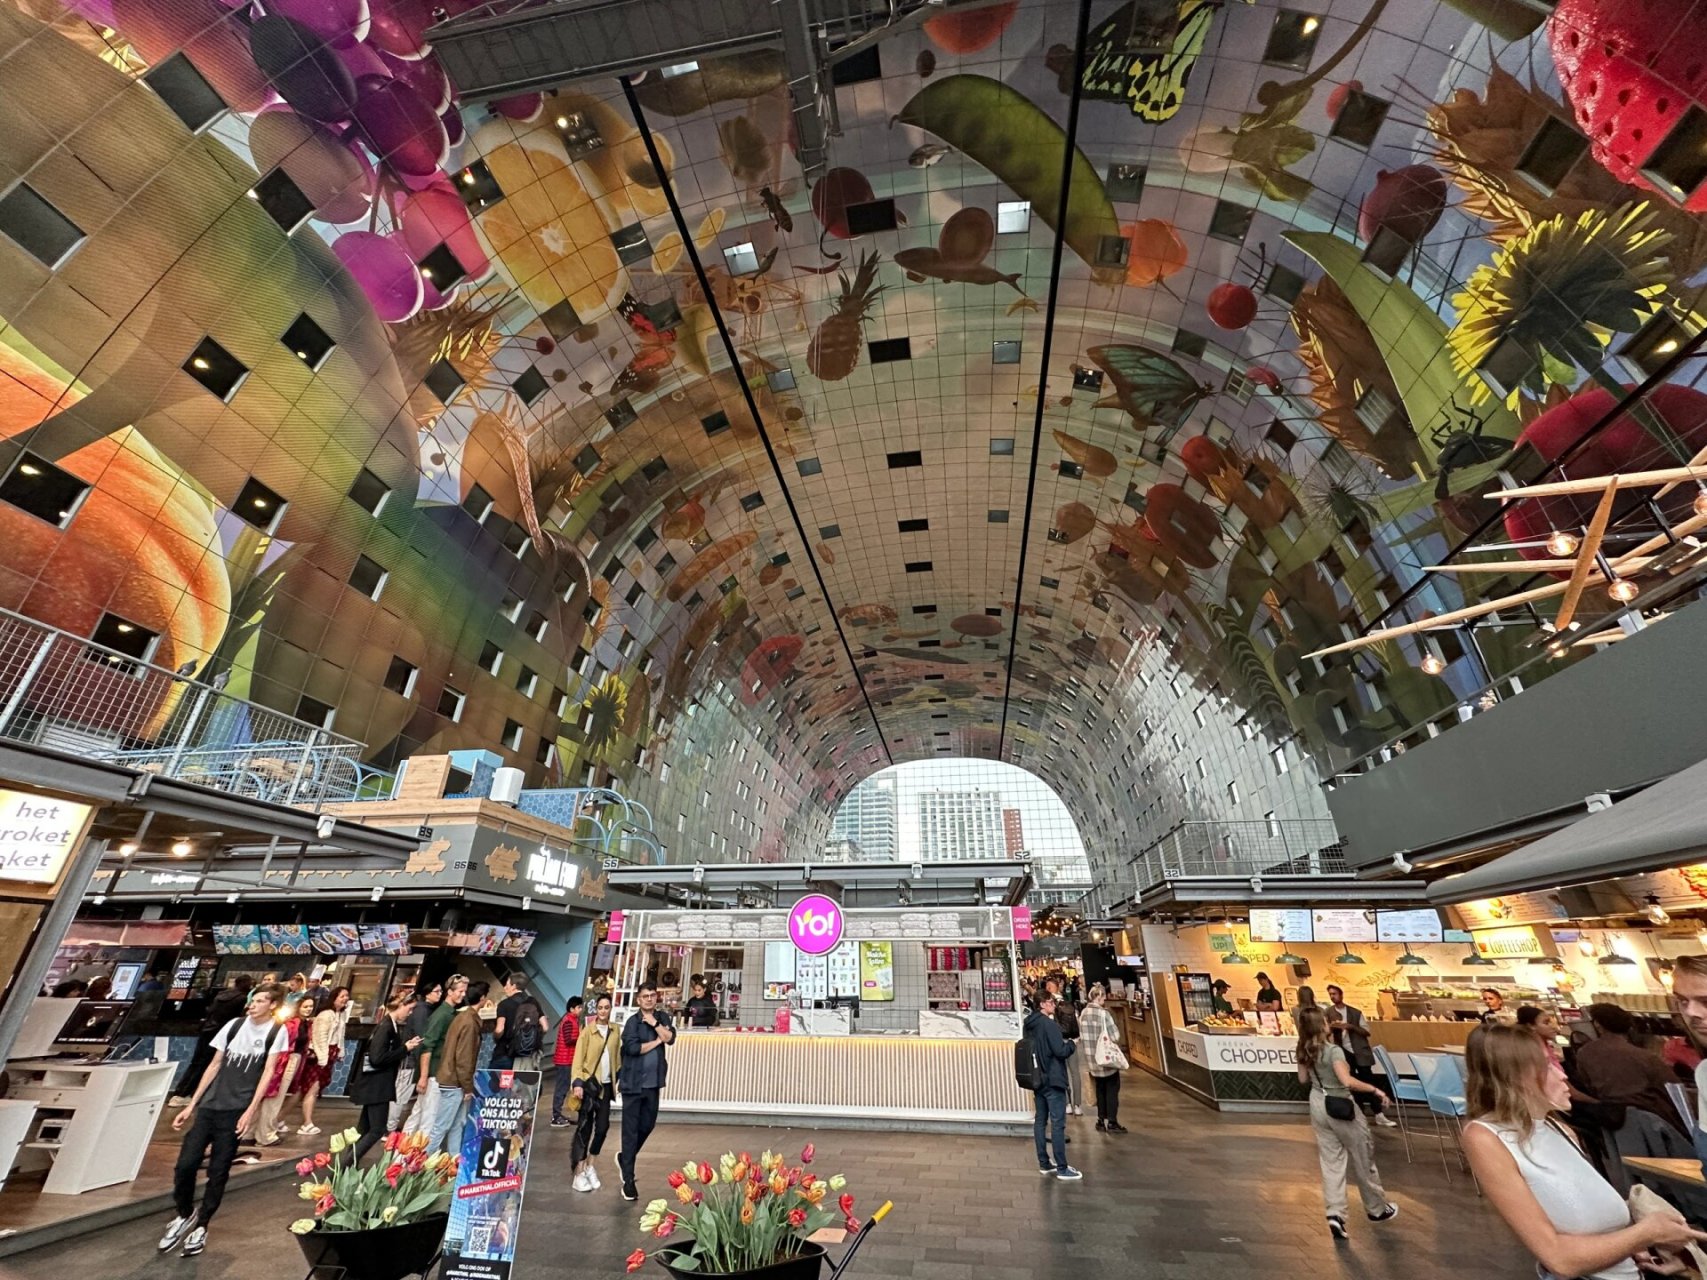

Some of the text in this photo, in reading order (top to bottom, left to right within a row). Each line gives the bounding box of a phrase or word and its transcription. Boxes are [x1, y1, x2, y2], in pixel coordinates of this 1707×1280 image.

[16, 801, 60, 820] het
[0, 826, 71, 843] roket
[1164, 869, 1179, 878] 32
[794, 909, 835, 937] YO!
[484, 1097, 522, 1109] VOLG JIJ
[480, 1108, 523, 1119] ONS AL OP
[482, 1119, 518, 1130] TIKTOK?
